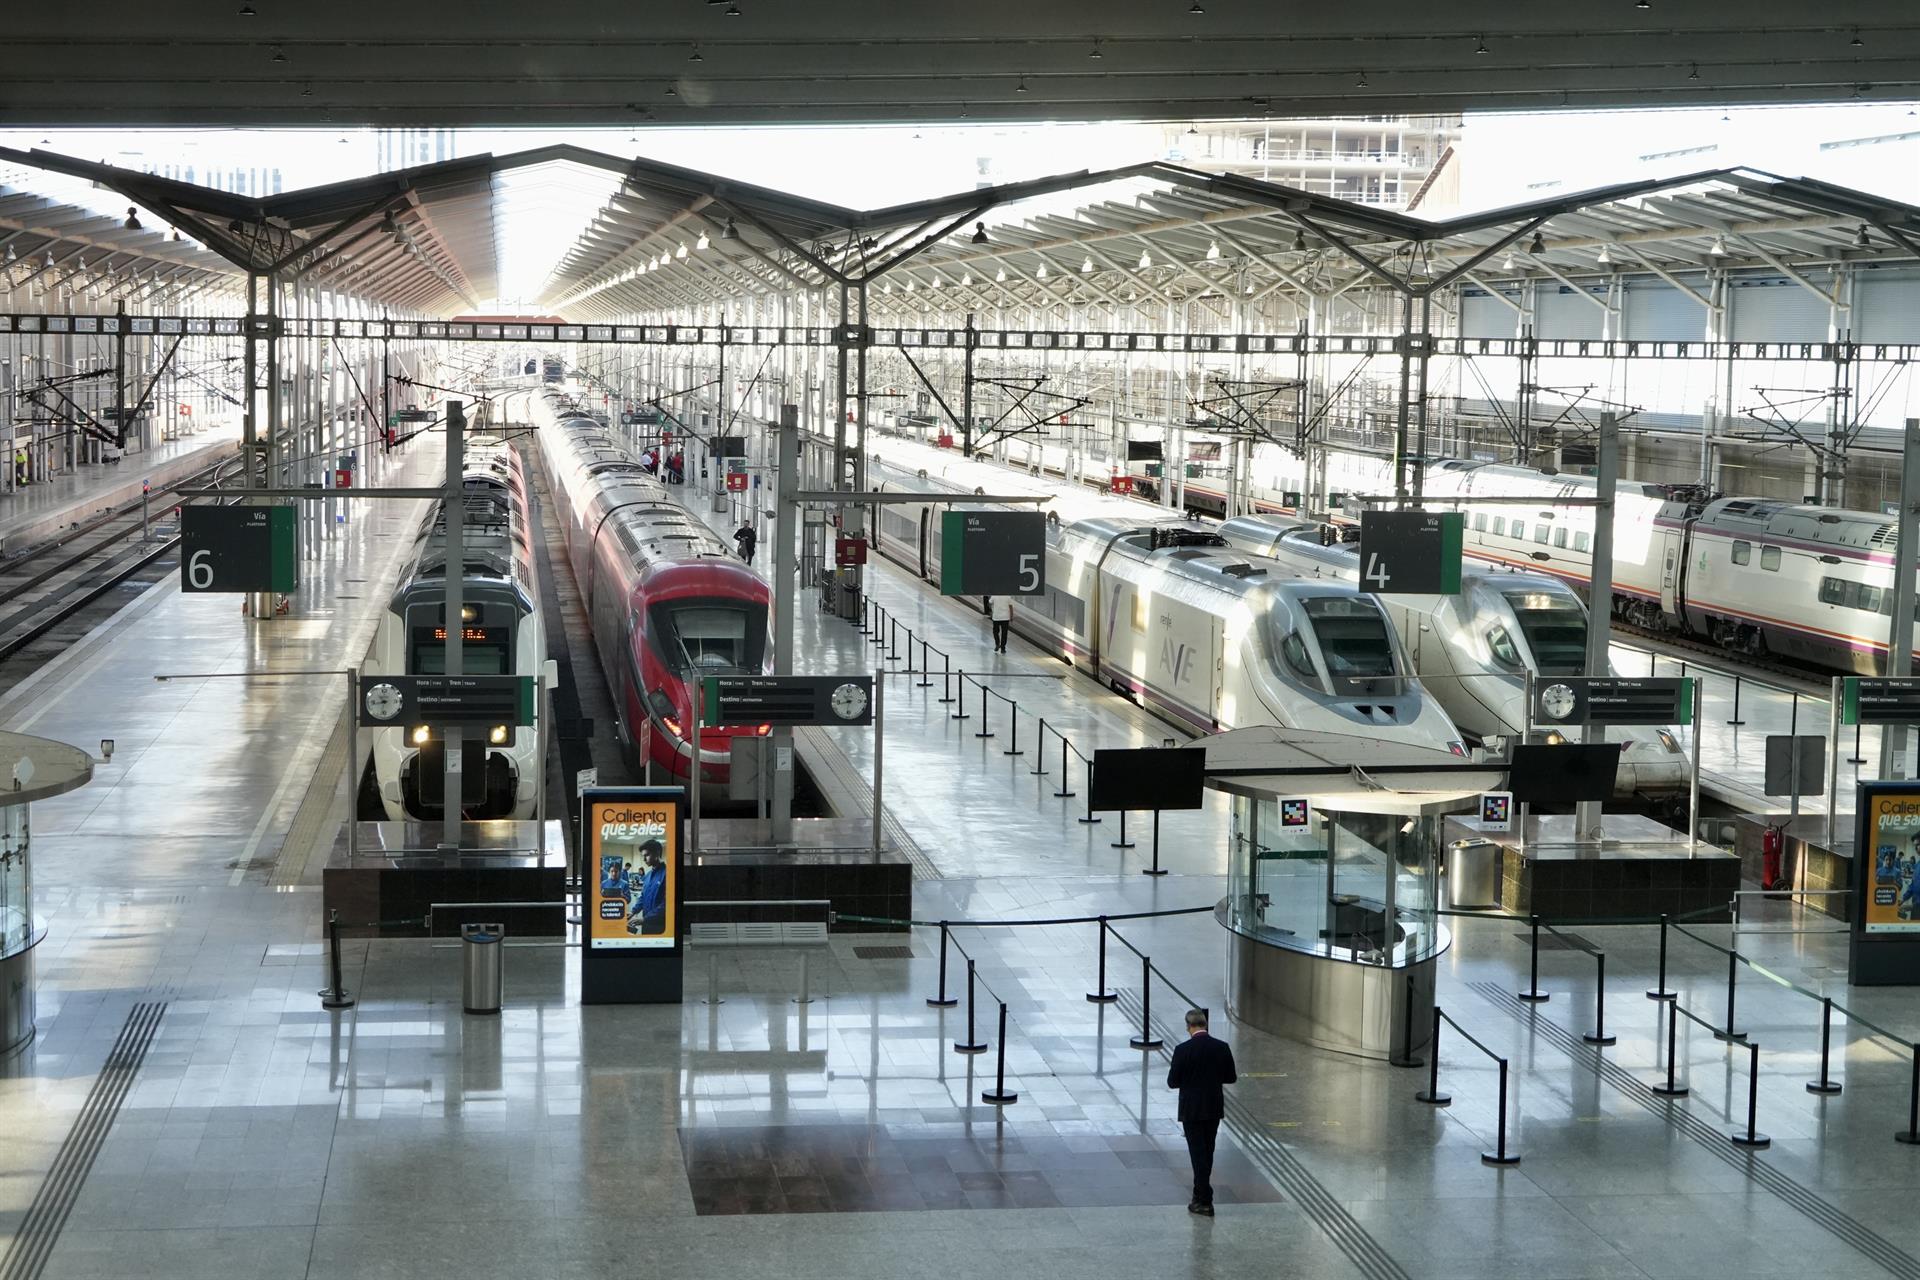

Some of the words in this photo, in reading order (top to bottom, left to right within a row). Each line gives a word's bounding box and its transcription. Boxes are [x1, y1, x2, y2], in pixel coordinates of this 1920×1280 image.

[254, 512, 266, 520] Vía
[968, 517, 980, 526] Vía
[1427, 518, 1439, 526] Vía
[189, 550, 214, 589] 6
[1019, 554, 1040, 592] 5
[1366, 552, 1391, 589] 4
[1159, 636, 1197, 688] AVE
[602, 808, 666, 823] Calienta
[1878, 814, 1901, 830] que
[601, 822, 626, 840] que
[629, 819, 666, 836] sales
